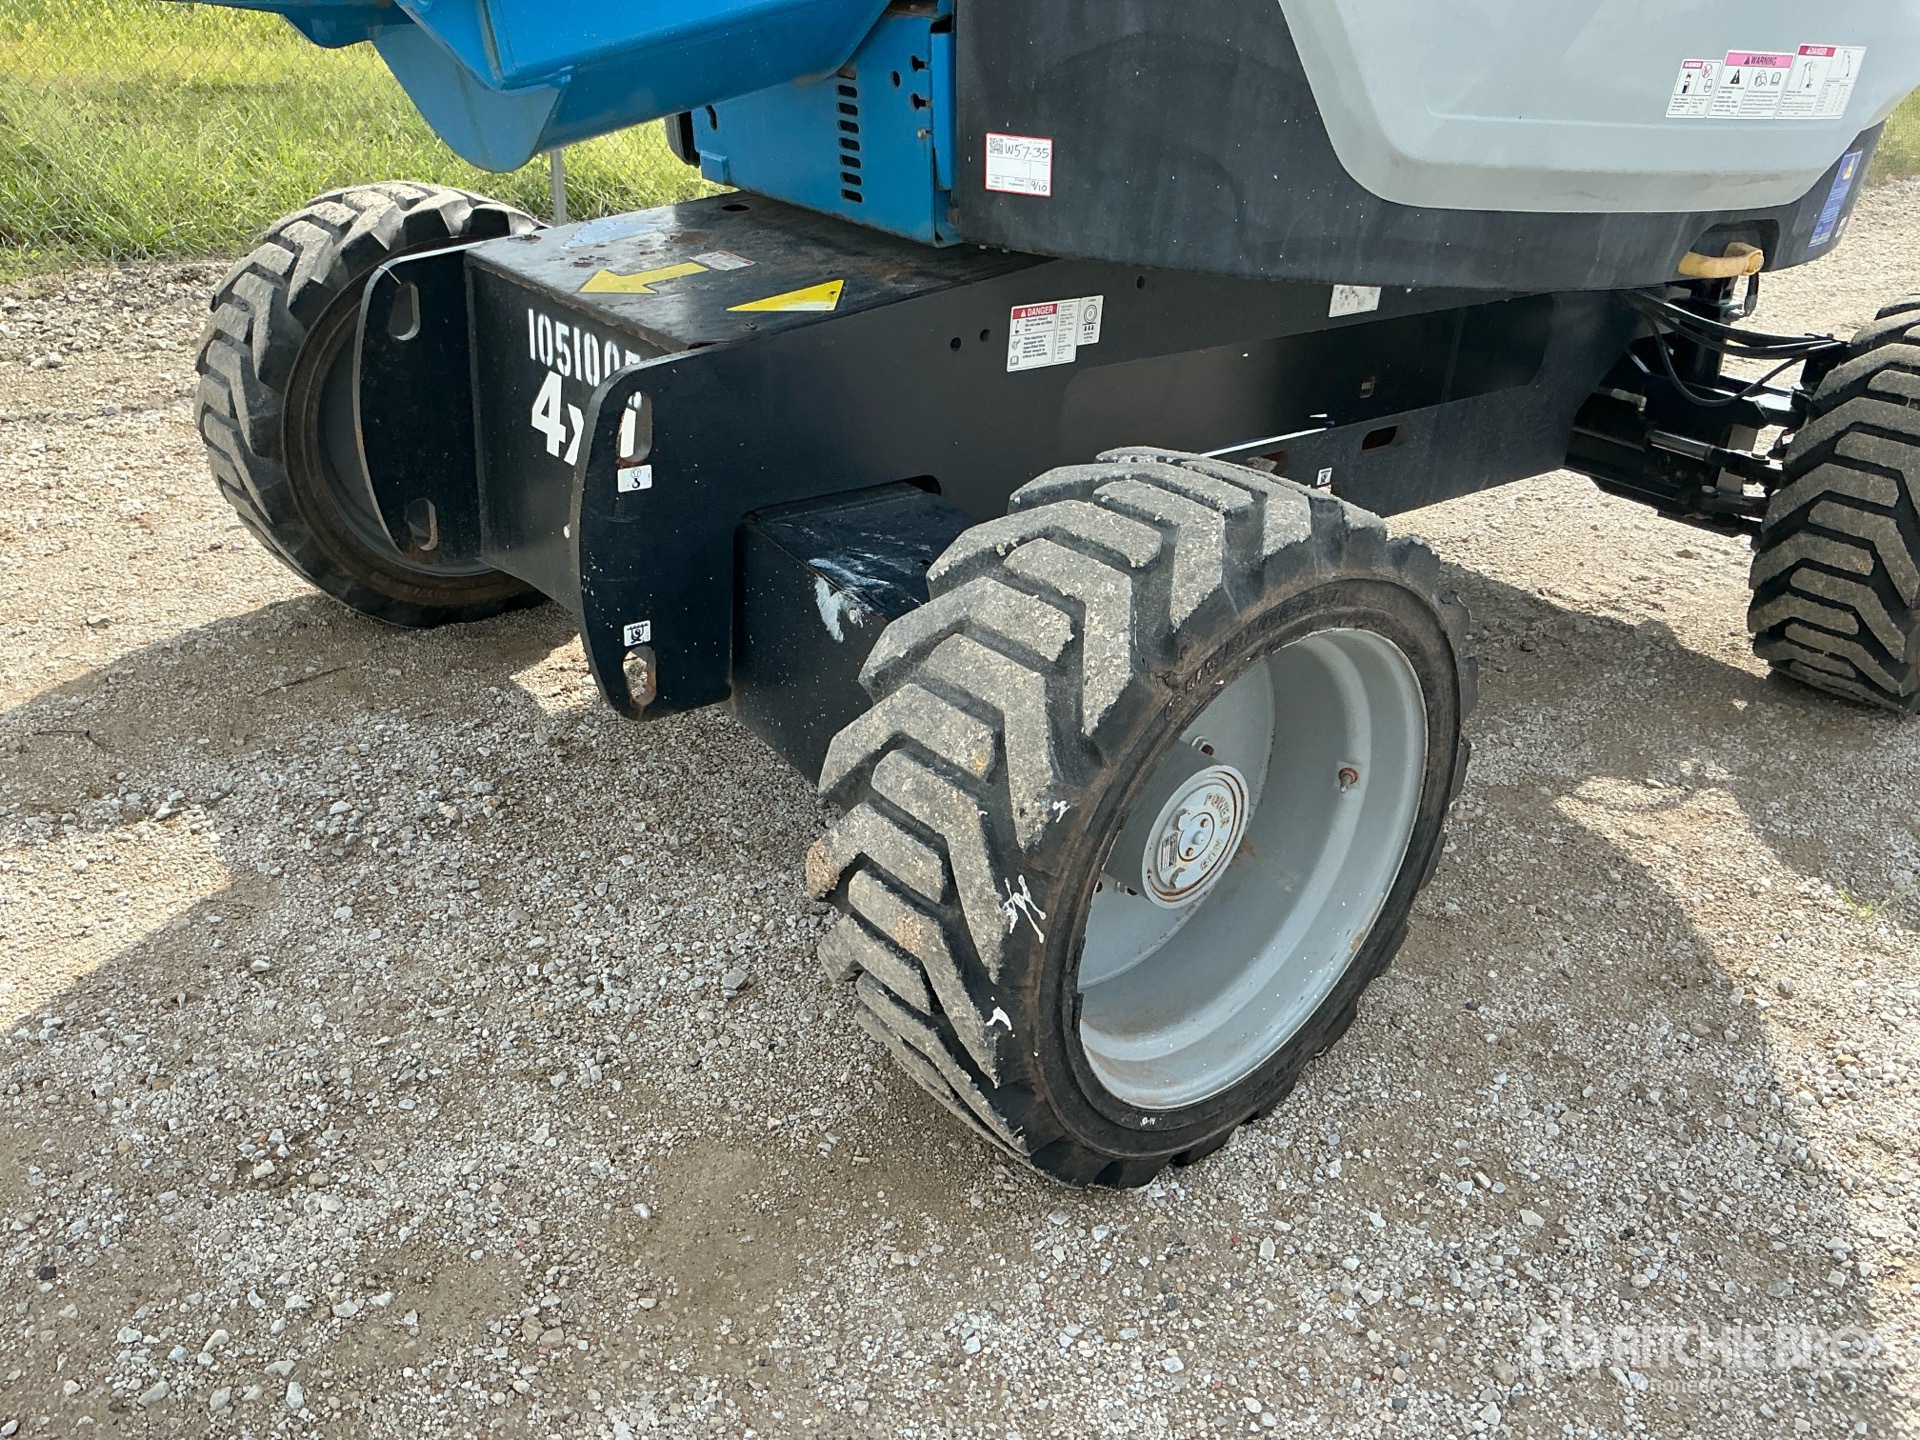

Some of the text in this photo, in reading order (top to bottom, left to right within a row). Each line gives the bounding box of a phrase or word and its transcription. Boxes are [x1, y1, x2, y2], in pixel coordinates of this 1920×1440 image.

[1750, 56, 1778, 66] WARNING
[1004, 142, 1050, 159] W57-35
[1027, 305, 1054, 317] DANGER
[1203, 792, 1231, 829] POWER
